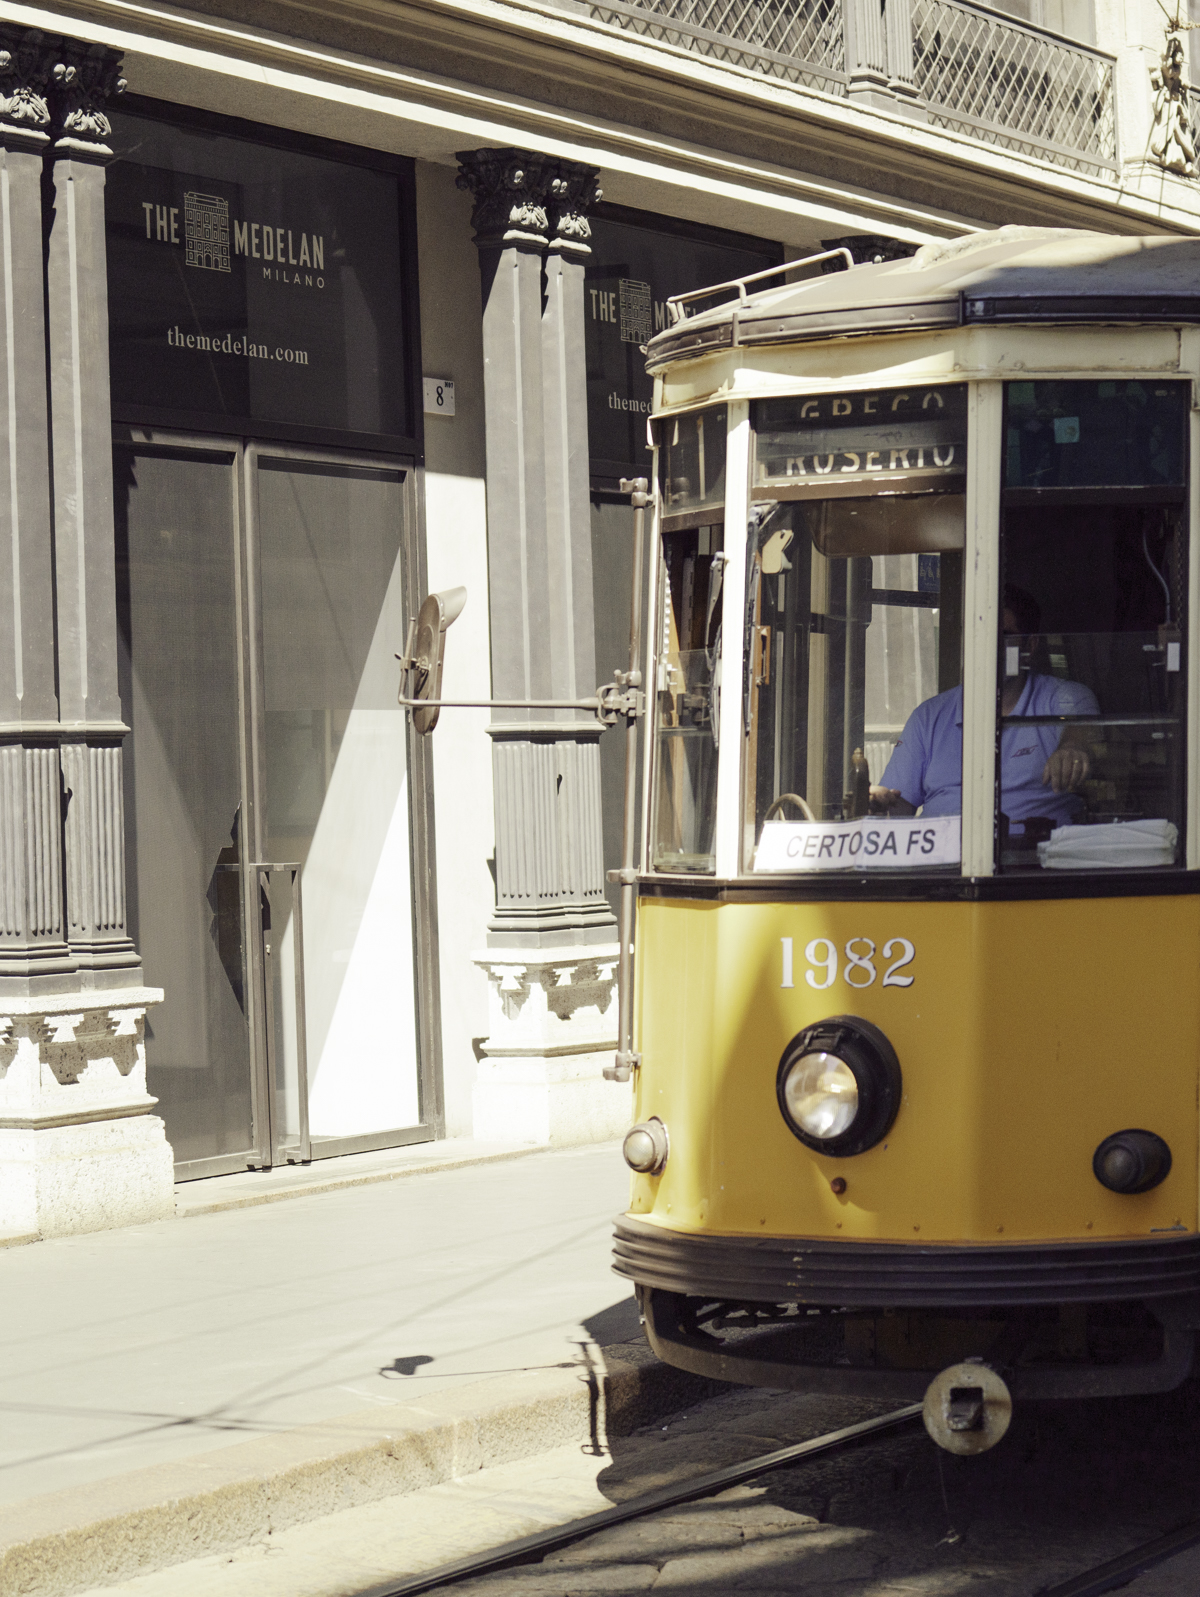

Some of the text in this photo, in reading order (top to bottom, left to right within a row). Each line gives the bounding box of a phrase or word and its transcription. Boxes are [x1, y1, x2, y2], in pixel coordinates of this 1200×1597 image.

[142, 202, 325, 270] THE MEDELAN
[263, 267, 325, 289] MILANO
[589, 289, 617, 323] THE
[167, 325, 309, 365] themedelan.com
[436, 385, 444, 407] 8
[786, 829, 936, 858] CERTOSA FS
[780, 937, 916, 989] 1982
